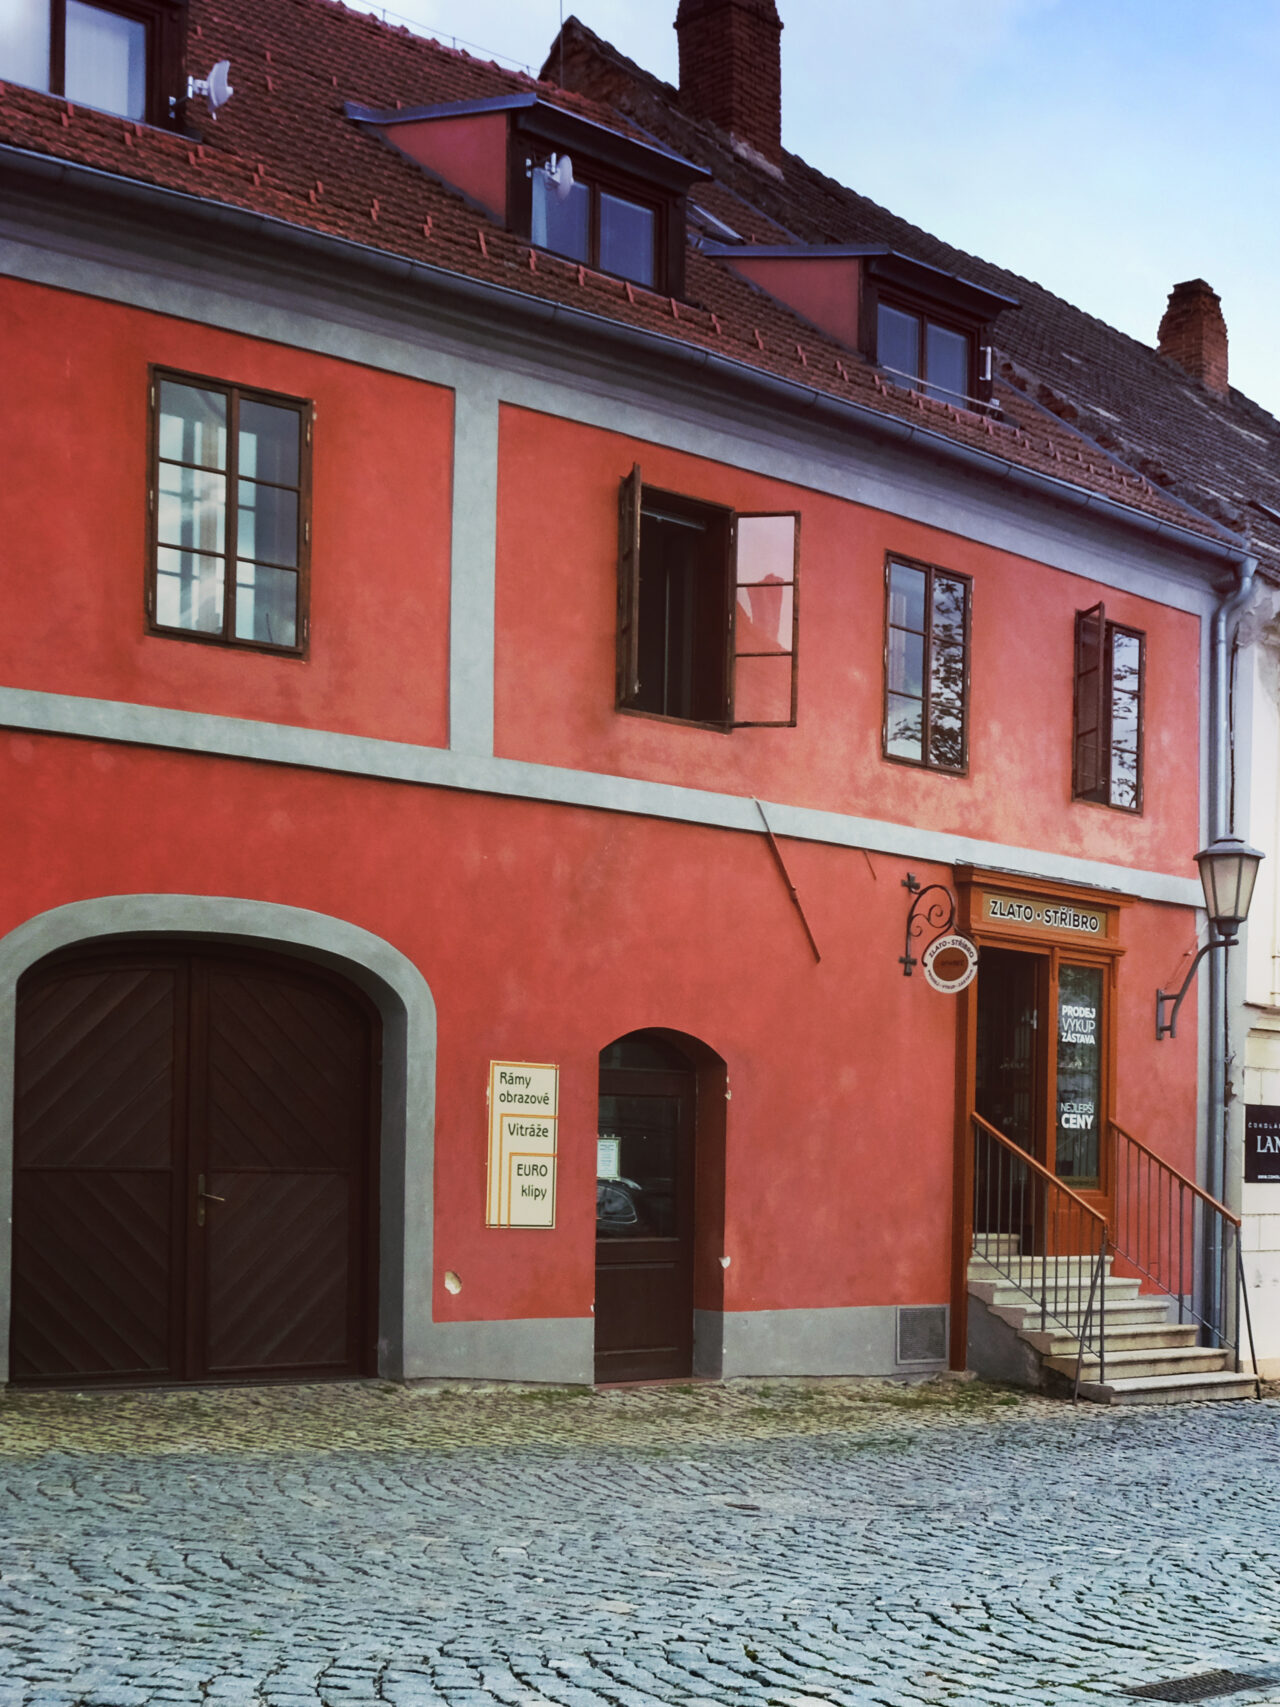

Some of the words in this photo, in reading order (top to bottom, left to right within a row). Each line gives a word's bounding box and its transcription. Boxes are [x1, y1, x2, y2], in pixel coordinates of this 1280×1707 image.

[990, 900, 1033, 921] ZLATO
[1044, 907, 1099, 931] STŘÍBRO
[929, 941, 947, 958] ZLATO
[1062, 1005, 1096, 1019] PRODEJ
[1061, 1031, 1096, 1045] ZÁSTAVA
[500, 1071, 532, 1089] Rámy
[499, 1090, 550, 1105] obrazové
[1061, 1113, 1094, 1130] CENY
[508, 1122, 549, 1138] Vitráže
[517, 1163, 548, 1177] EURO
[521, 1184, 547, 1201] klipy
